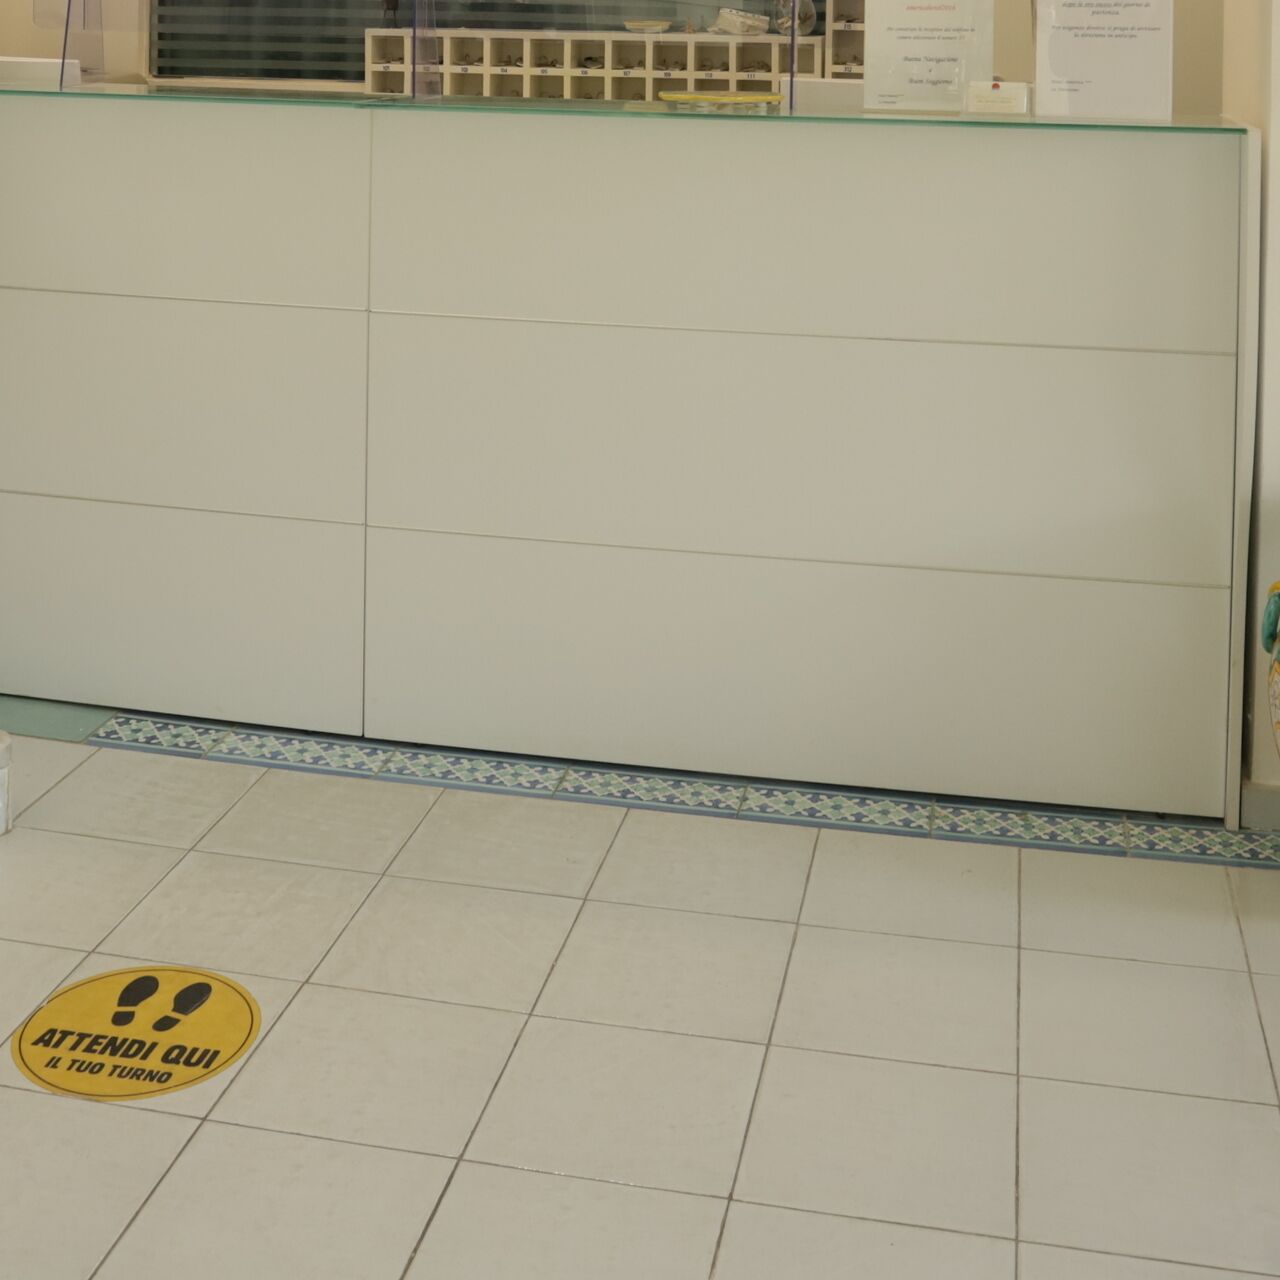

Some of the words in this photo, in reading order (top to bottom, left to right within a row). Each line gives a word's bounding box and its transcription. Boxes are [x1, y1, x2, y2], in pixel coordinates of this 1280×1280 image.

[31, 1027, 159, 1062] ATTENDI
[160, 1044, 221, 1070] QUI
[44, 1056, 60, 1069] IL
[67, 1058, 105, 1075] TUO
[108, 1064, 173, 1084] TURNO
